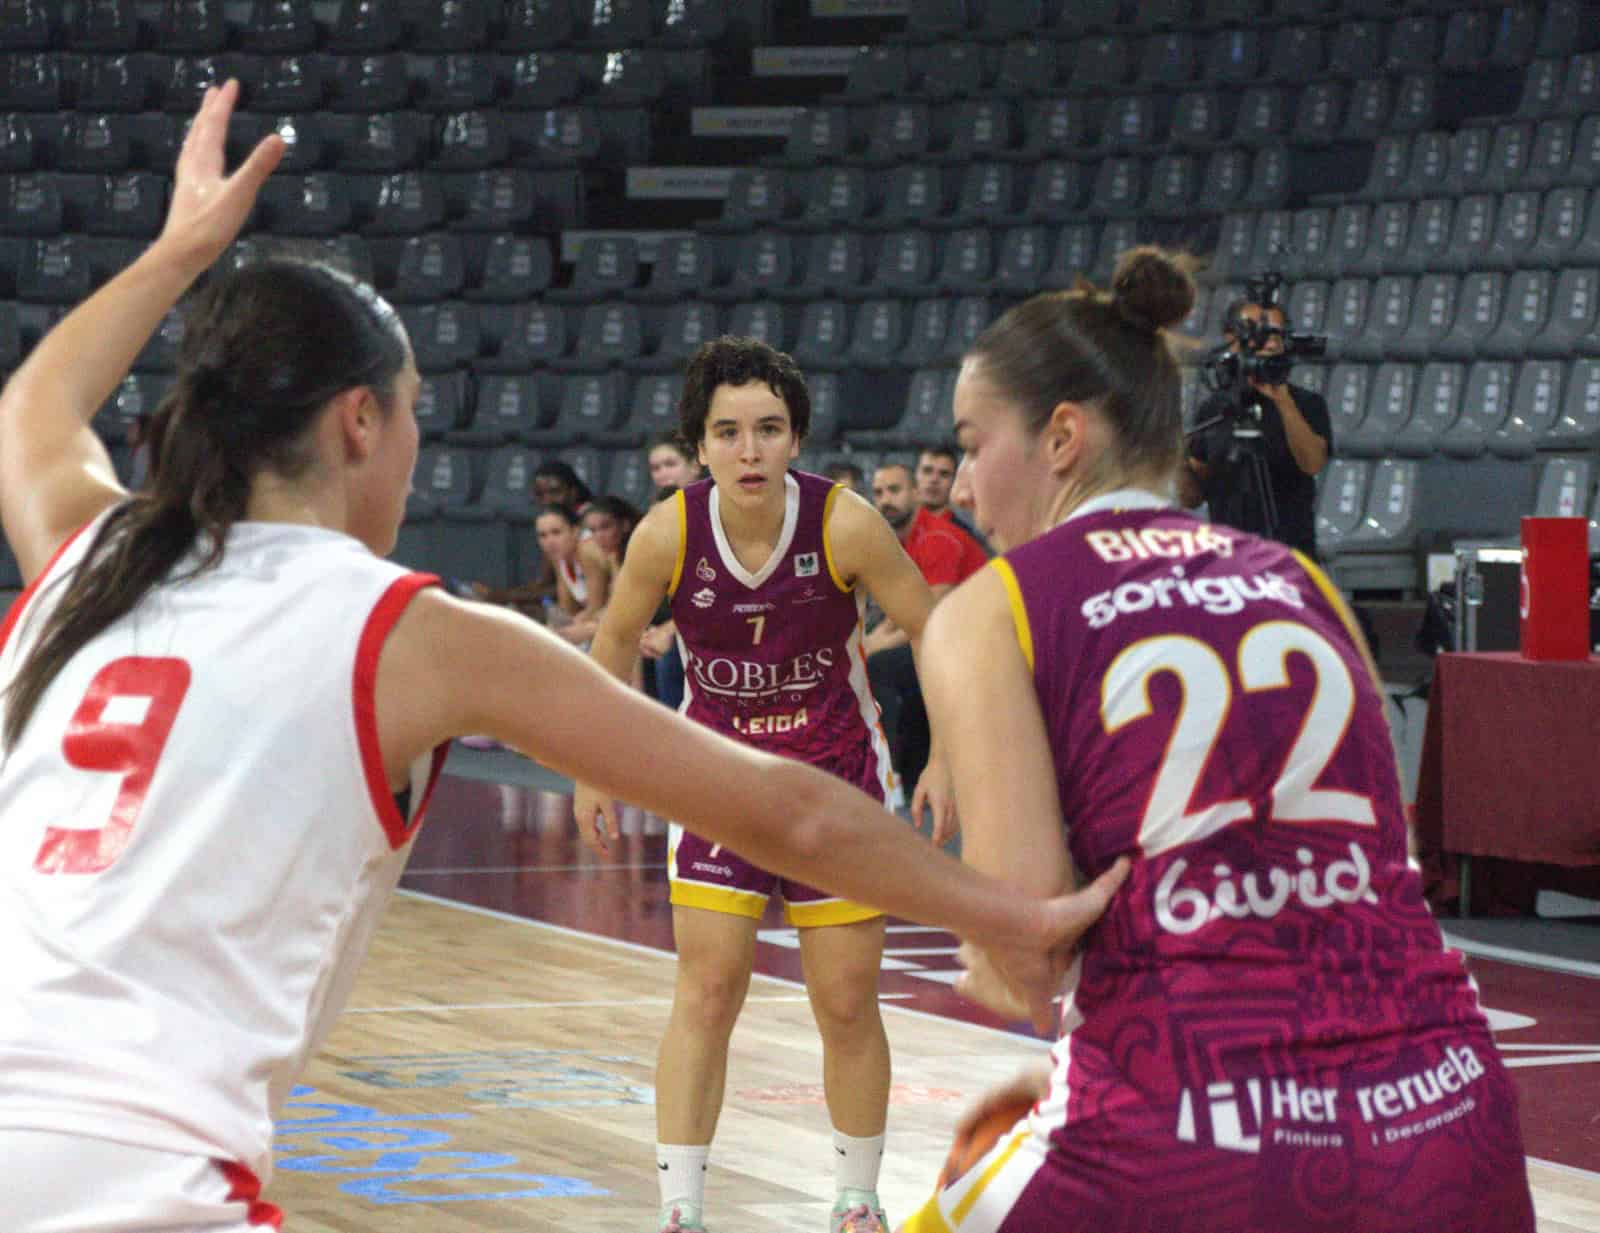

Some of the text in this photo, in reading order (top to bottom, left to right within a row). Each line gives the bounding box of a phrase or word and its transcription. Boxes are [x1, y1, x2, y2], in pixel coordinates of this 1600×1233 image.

[746, 616, 765, 645] 7
[32, 656, 192, 874] 9
[1100, 619, 1377, 858] 22
[1273, 1128, 1343, 1147] Pintura
